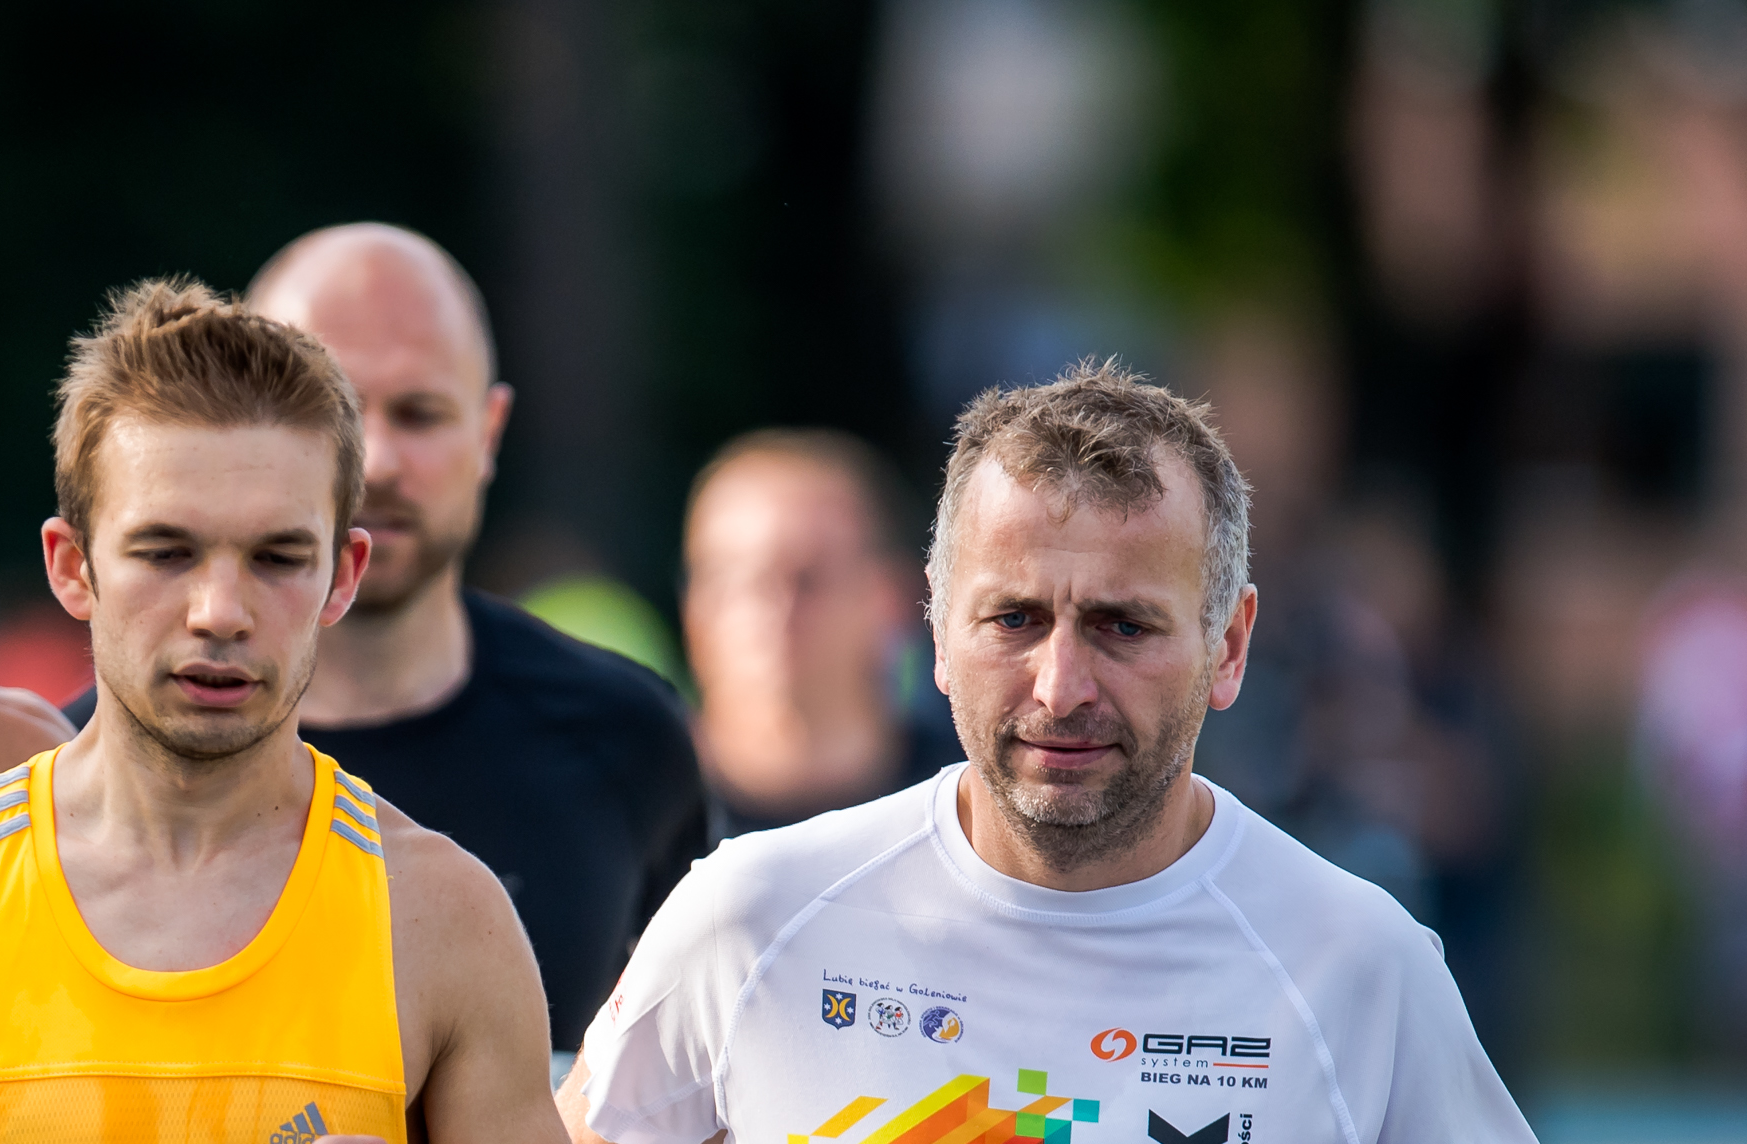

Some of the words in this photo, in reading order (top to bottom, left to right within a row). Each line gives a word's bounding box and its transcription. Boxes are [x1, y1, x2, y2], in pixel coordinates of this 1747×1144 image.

[823, 968, 853, 986] Lubię
[1142, 1033, 1272, 1058] GAZ
[1141, 1057, 1209, 1068] system
[1140, 1071, 1182, 1085] BIEG
[1187, 1074, 1211, 1086] NA
[1217, 1075, 1236, 1087] 10
[1241, 1077, 1268, 1089] KM
